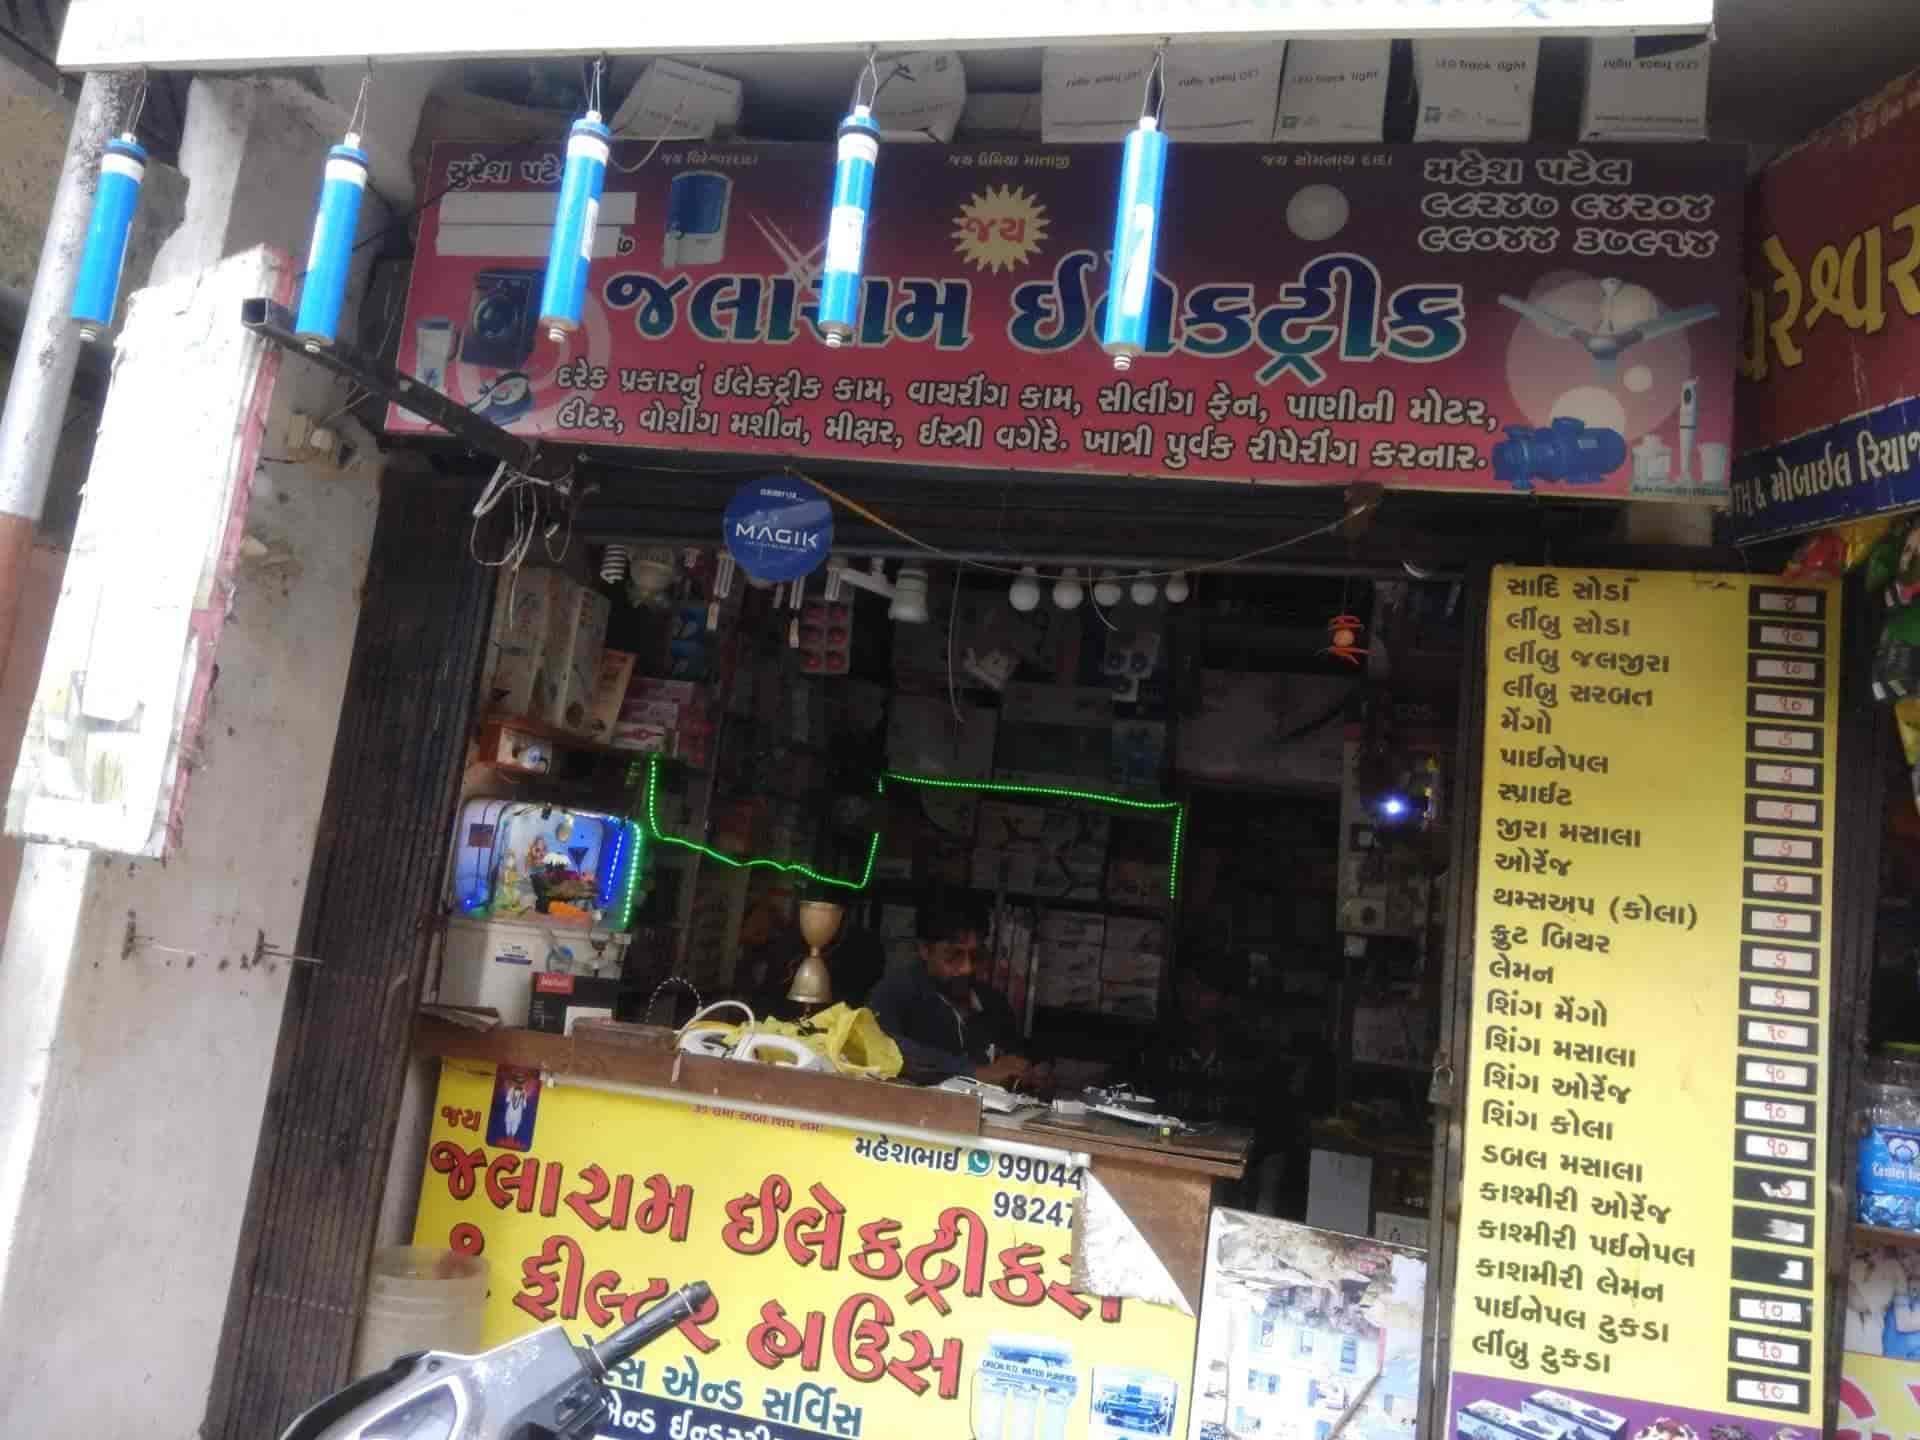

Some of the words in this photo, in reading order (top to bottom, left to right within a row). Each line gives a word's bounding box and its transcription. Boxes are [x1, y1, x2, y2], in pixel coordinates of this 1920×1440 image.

[520, 152, 568, 184] પટે
[1424, 151, 1524, 186] મહેશ
[1536, 151, 1632, 187] પટેલ
[965, 216, 1028, 246] જય
[557, 358, 608, 391] દરેક
[618, 362, 704, 407] પ્રકારનું
[833, 375, 891, 408] કામ,
[1020, 384, 1082, 415] કામ,
[1206, 382, 1268, 424] ફેન,
[1286, 387, 1395, 424] પાણીની
[1408, 387, 1498, 432] મોટર,
[557, 402, 625, 434] હીટર,
[728, 408, 812, 445] મશીન,
[994, 416, 1068, 454] વગેરે.
[1083, 423, 1154, 458] ખાત્રી
[1370, 439, 1489, 471] કરનાર.
[735, 522, 820, 549] MAGIK
[1506, 573, 1561, 600] સાદિ
[1506, 605, 1562, 641] લીંબુ
[1572, 610, 1631, 637] સોડા
[1503, 640, 1561, 676] લીંબુ
[1569, 650, 1671, 677] જલજીરા
[1502, 675, 1560, 710] લીંબુ
[1569, 683, 1654, 708] સરબત
[1500, 707, 1553, 736] મેંગો
[1499, 745, 1611, 775] પાઈનેપલ
[1495, 816, 1547, 842] જીરા
[1558, 823, 1642, 848] મસાલા
[1492, 887, 1596, 917] થમ્સઅપ
[1608, 894, 1698, 931] (કોલા)
[1540, 922, 1611, 954] બિયર
[1488, 952, 1555, 985] લેમન
[1486, 988, 1543, 1020] શિંગ
[1553, 996, 1609, 1027] મેંગો
[1484, 1024, 1541, 1057] શિંગ
[1552, 1038, 1637, 1069] મસાલા
[1482, 1062, 1540, 1094] શિંગ
[439, 1104, 483, 1133] જય
[1481, 1098, 1539, 1132] શિંગ
[1550, 1108, 1614, 1141] કોલા
[854, 1135, 961, 1173] મહેશભાઈ
[997, 1152, 1084, 1191] 99044
[1480, 1142, 1548, 1171] ડબલ
[1559, 1153, 1645, 1184] મસાલા
[429, 1140, 695, 1243] જલારામ
[1478, 1180, 1579, 1214] કાશ્મીરી
[1476, 1218, 1578, 1252] કાશ્મીરી
[1596, 1267, 1665, 1304] લેમન
[1473, 1294, 1587, 1331] પાઈનેપલ
[1597, 1311, 1670, 1345] ટુકડા
[746, 1292, 964, 1400] હાઉસ
[1471, 1330, 1531, 1371] લીંબુ
[1540, 1342, 1612, 1374] ટુકડા
[661, 1355, 744, 1412] એન્ડ
[761, 1381, 864, 1438] સર્વિસ
